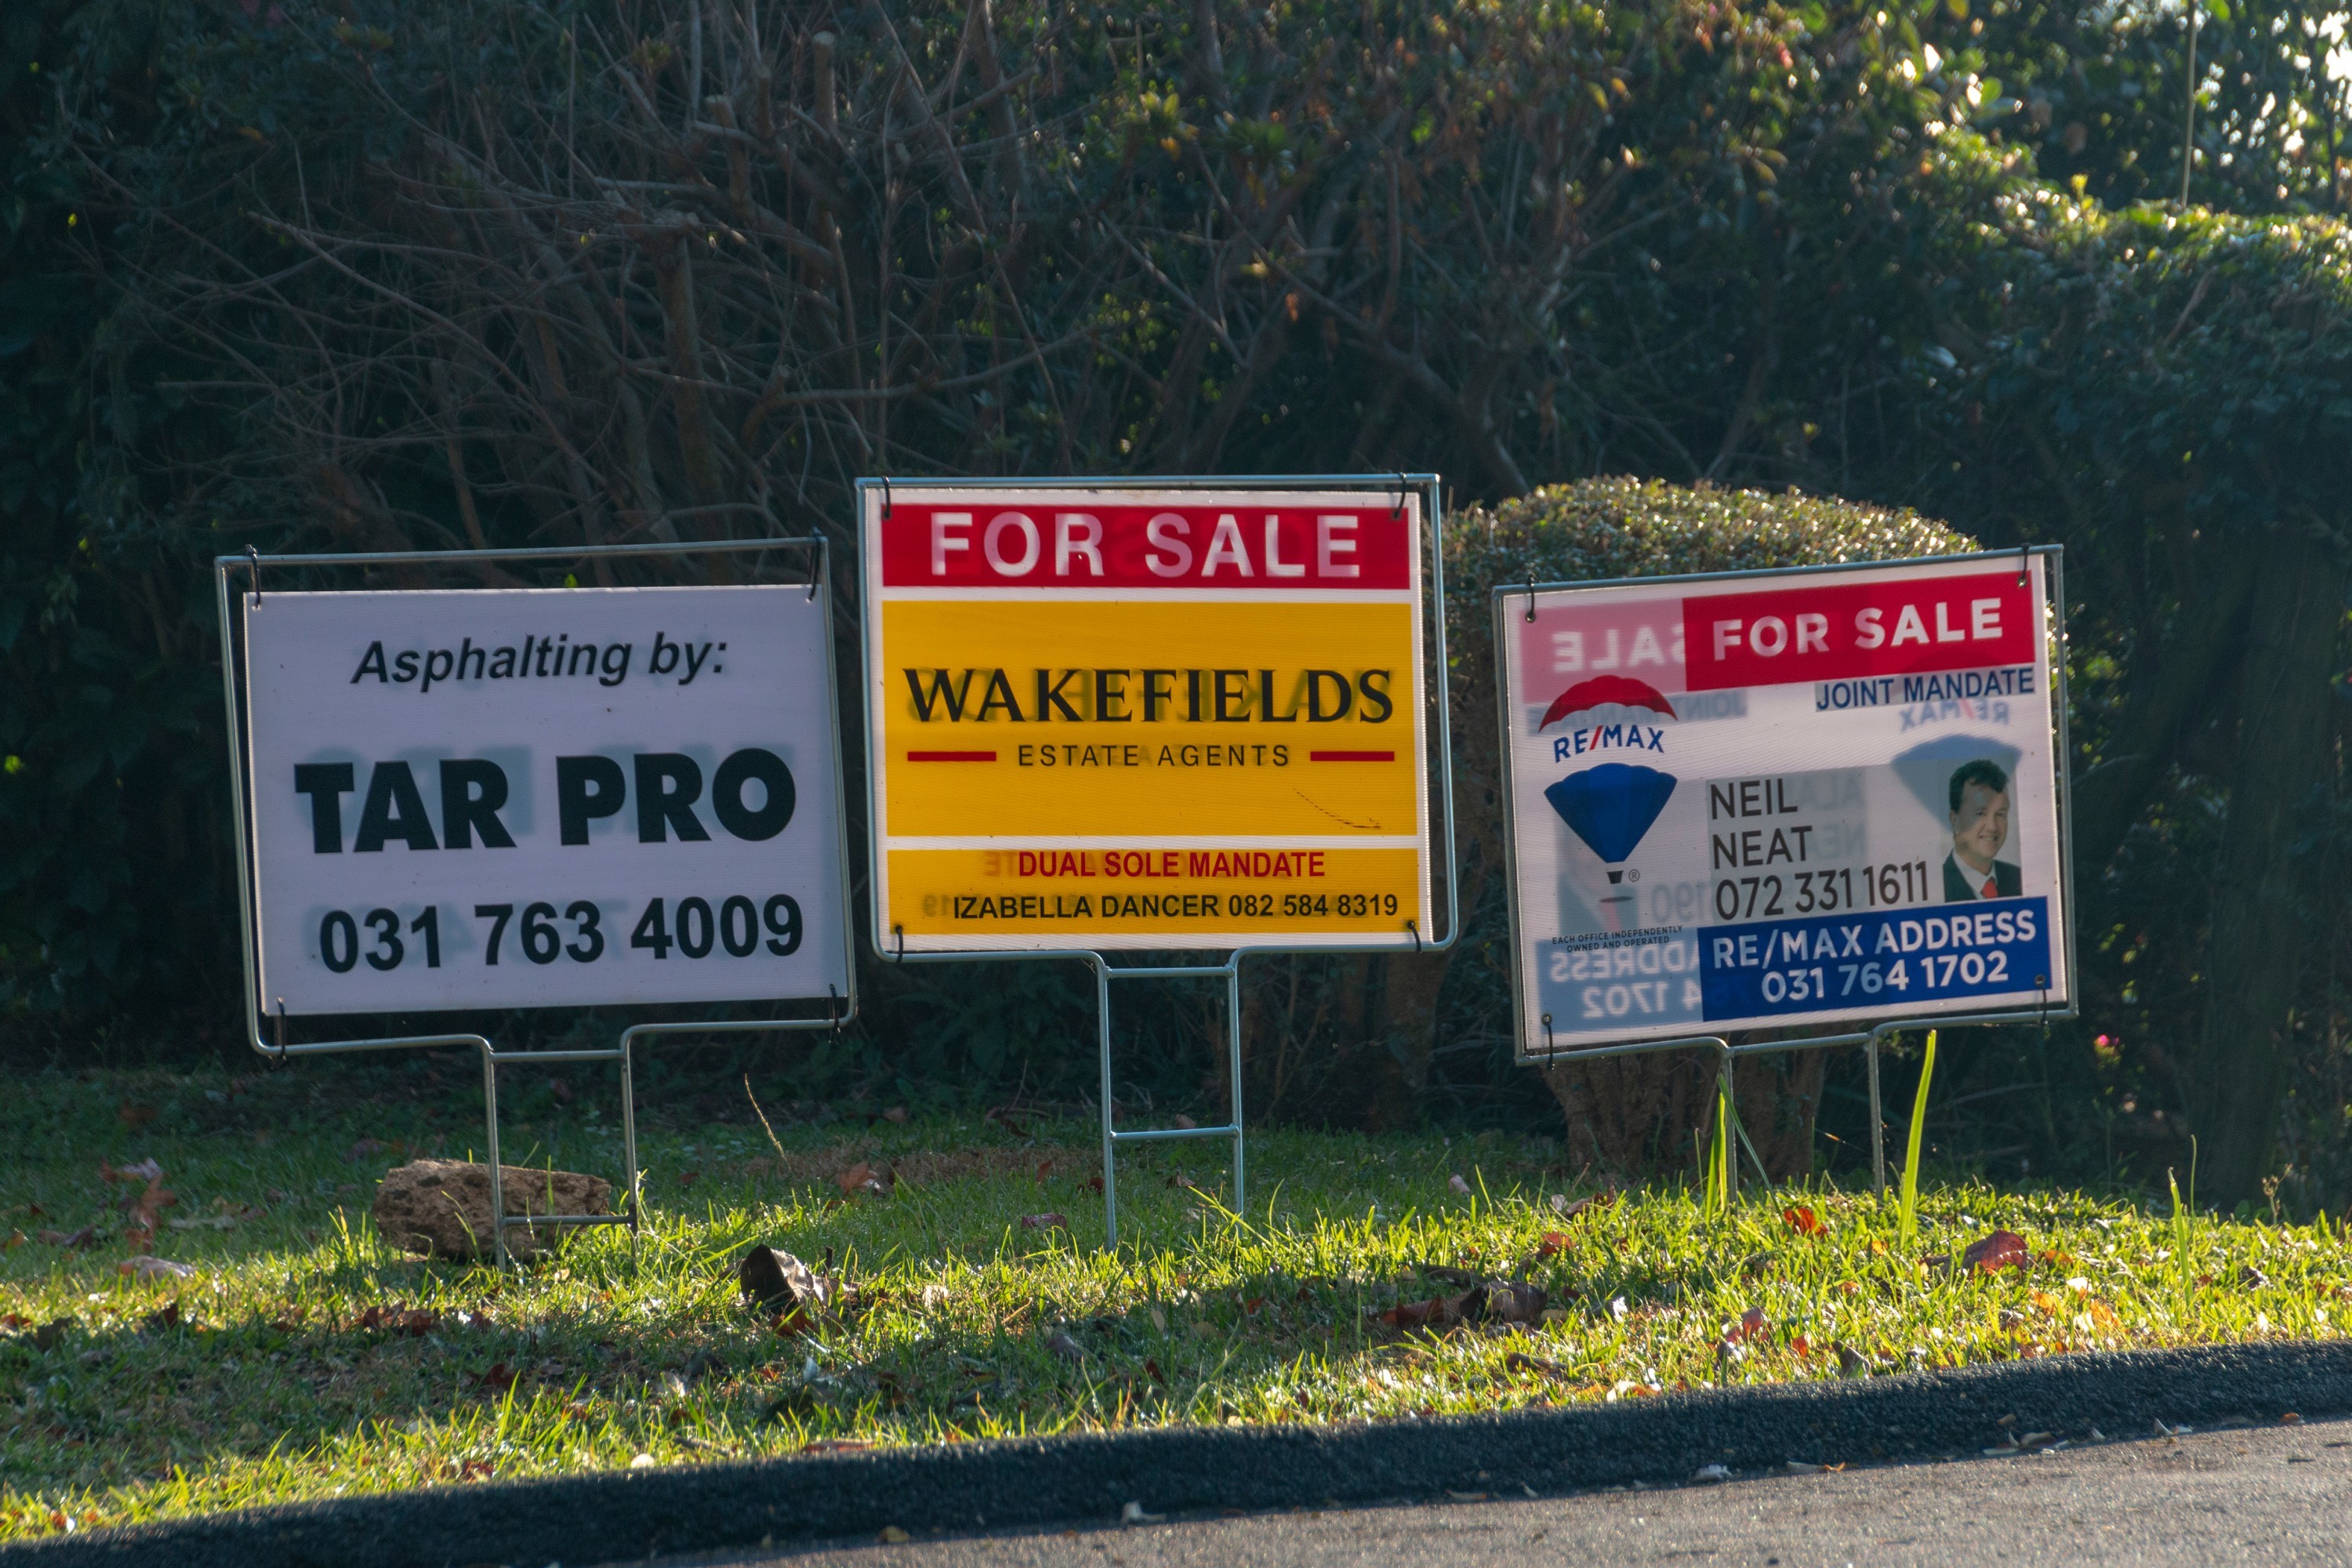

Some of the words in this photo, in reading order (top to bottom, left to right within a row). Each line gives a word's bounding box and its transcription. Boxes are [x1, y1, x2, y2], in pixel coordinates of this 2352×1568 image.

[931, 511, 1105, 576] FOR
[1145, 513, 1360, 578] SALE
[1713, 613, 1829, 661] FOR
[1854, 597, 2002, 649] SALE
[350, 633, 631, 692] Asphalting
[648, 632, 726, 684] by:
[902, 668, 1393, 723] WAKEFIELDS
[1817, 678, 1895, 710] JOINT
[1904, 667, 2034, 702] MANDATE
[1018, 745, 1138, 766] ESTATE
[1158, 745, 1290, 766] AGENTS
[1553, 724, 1664, 764] RE/MAX
[294, 758, 517, 853] TAR
[556, 748, 796, 845] PRO
[1711, 778, 1798, 820] NEIL
[1019, 851, 1095, 877] DUAL
[1105, 851, 1179, 877] SOLE
[1189, 851, 1325, 877] MANDATE
[1712, 826, 1813, 869] NEAT
[954, 896, 1093, 919] IZABELLA
[1102, 895, 1220, 917] DANCER
[1229, 894, 1273, 916] 082
[1283, 894, 1328, 916] 584
[1338, 894, 1398, 916] 8319
[1716, 875, 1784, 920] 072
[1795, 868, 1853, 913] 331
[1863, 861, 1928, 906] 1611
[319, 906, 441, 973] 031
[474, 900, 604, 965] 763
[630, 895, 803, 959] 4009
[1552, 935, 1575, 945] EACH
[1578, 932, 1609, 942] OFFICE
[1611, 925, 1683, 939] INDEPENDENTLY
[1566, 942, 1599, 953] OWNED
[1602, 940, 1621, 949] AND
[1624, 935, 1670, 948] OPERATED
[1713, 924, 1864, 969] RE/MAX
[1875, 909, 2037, 954] ADDRESS
[1761, 967, 1825, 1004] 031
[1838, 959, 1909, 996] 764
[1920, 950, 2009, 989] 1702
